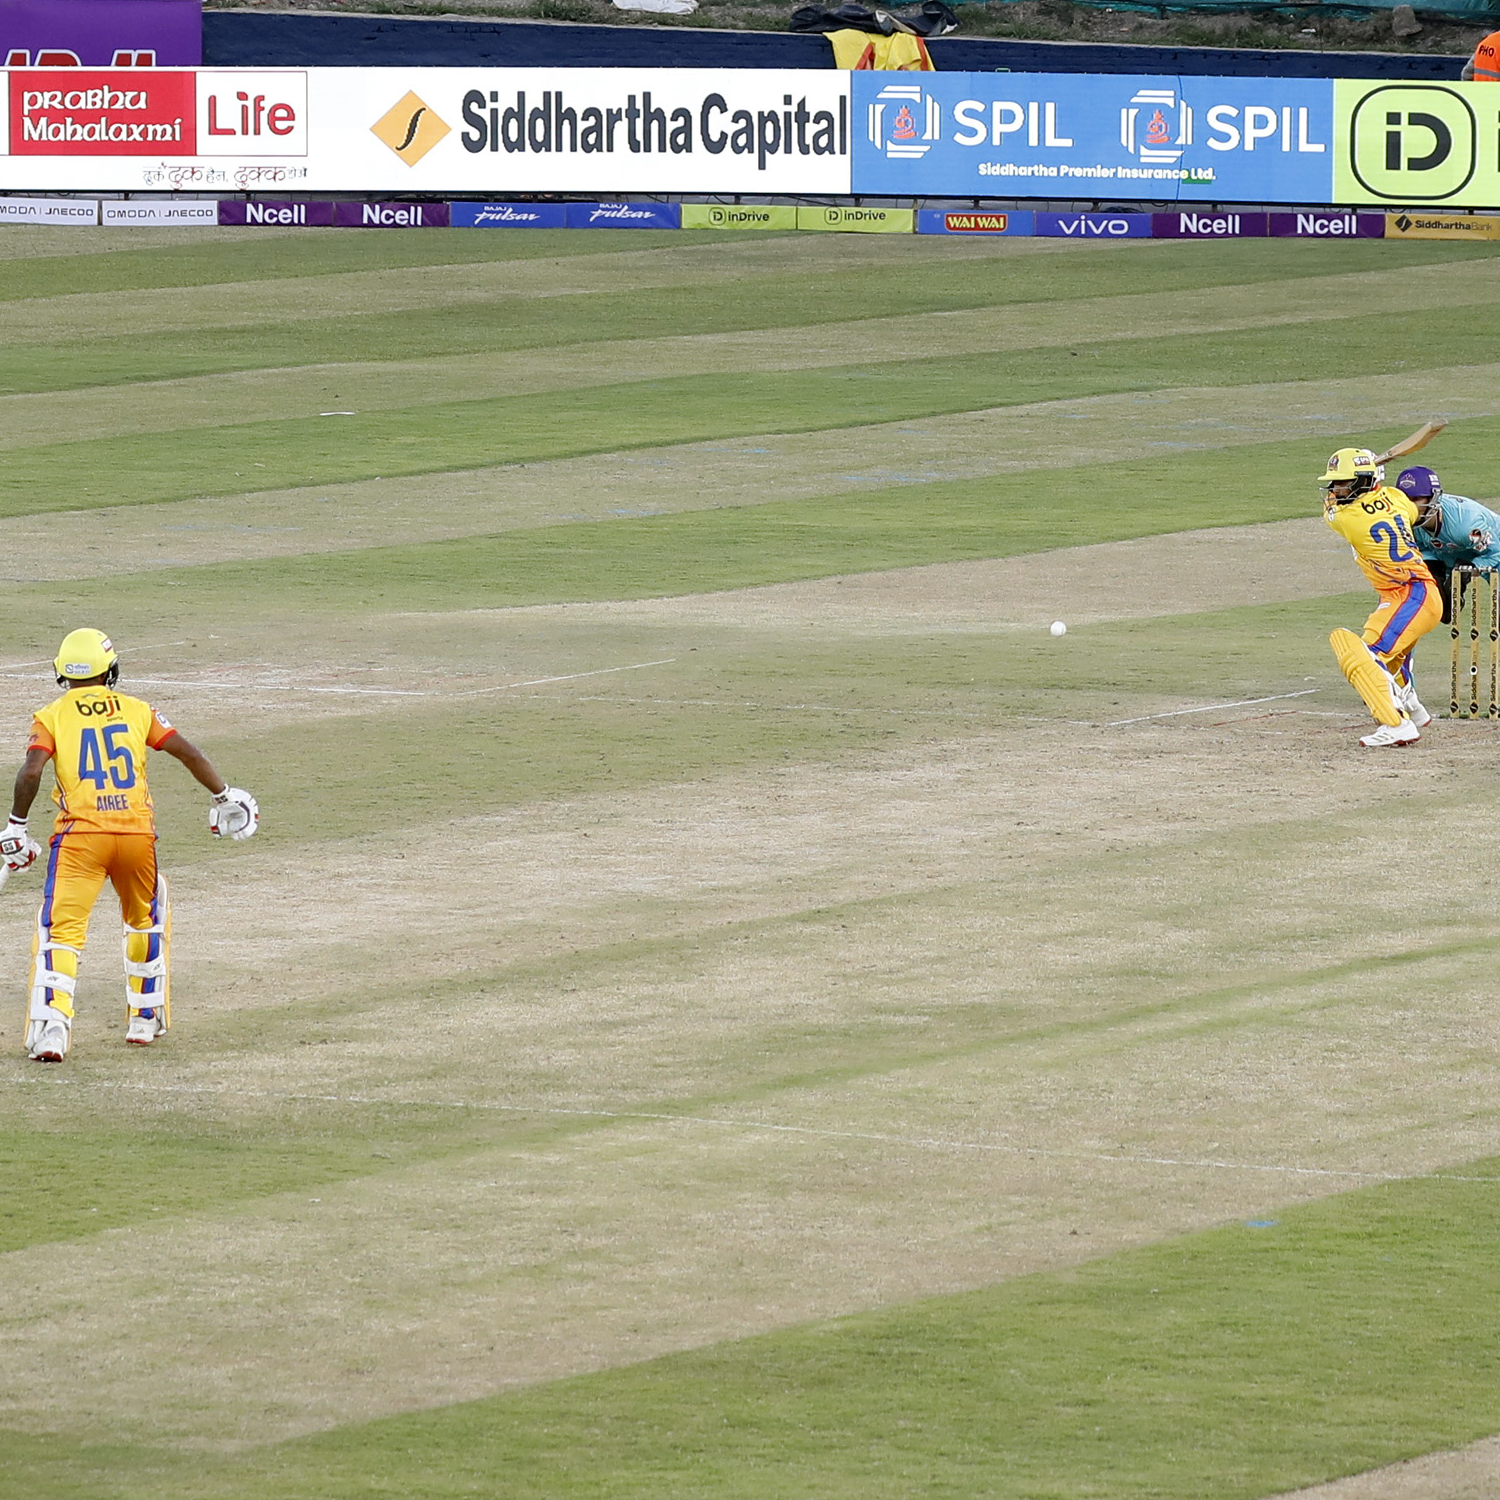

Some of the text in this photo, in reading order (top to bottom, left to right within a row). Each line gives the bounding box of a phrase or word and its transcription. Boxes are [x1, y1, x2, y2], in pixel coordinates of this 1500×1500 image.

[208, 90, 296, 137] Life
[460, 89, 847, 171] Siddhartha Capital
[953, 100, 1326, 153] SPIL SPIL
[978, 162, 1217, 181] Siddhartha Premier Insurance Ltd.
[45, 206, 94, 217] JAECOO
[106, 208, 213, 219] OMODA JAECOO
[246, 203, 306, 224] Ncell
[362, 204, 422, 225] Ncell
[474, 207, 540, 224] pulsar
[589, 204, 656, 222] pulsar
[727, 211, 770, 222] inDrive
[843, 210, 886, 221] inDrive
[946, 215, 1005, 229] WAI WAI
[1057, 214, 1129, 235] vivo
[1179, 212, 1240, 234] Ncell
[1296, 213, 1357, 235] Ncell
[1361, 492, 1394, 515] baji
[74, 695, 121, 717] baji
[78, 724, 136, 791] 45
[96, 794, 129, 812] AIREE
